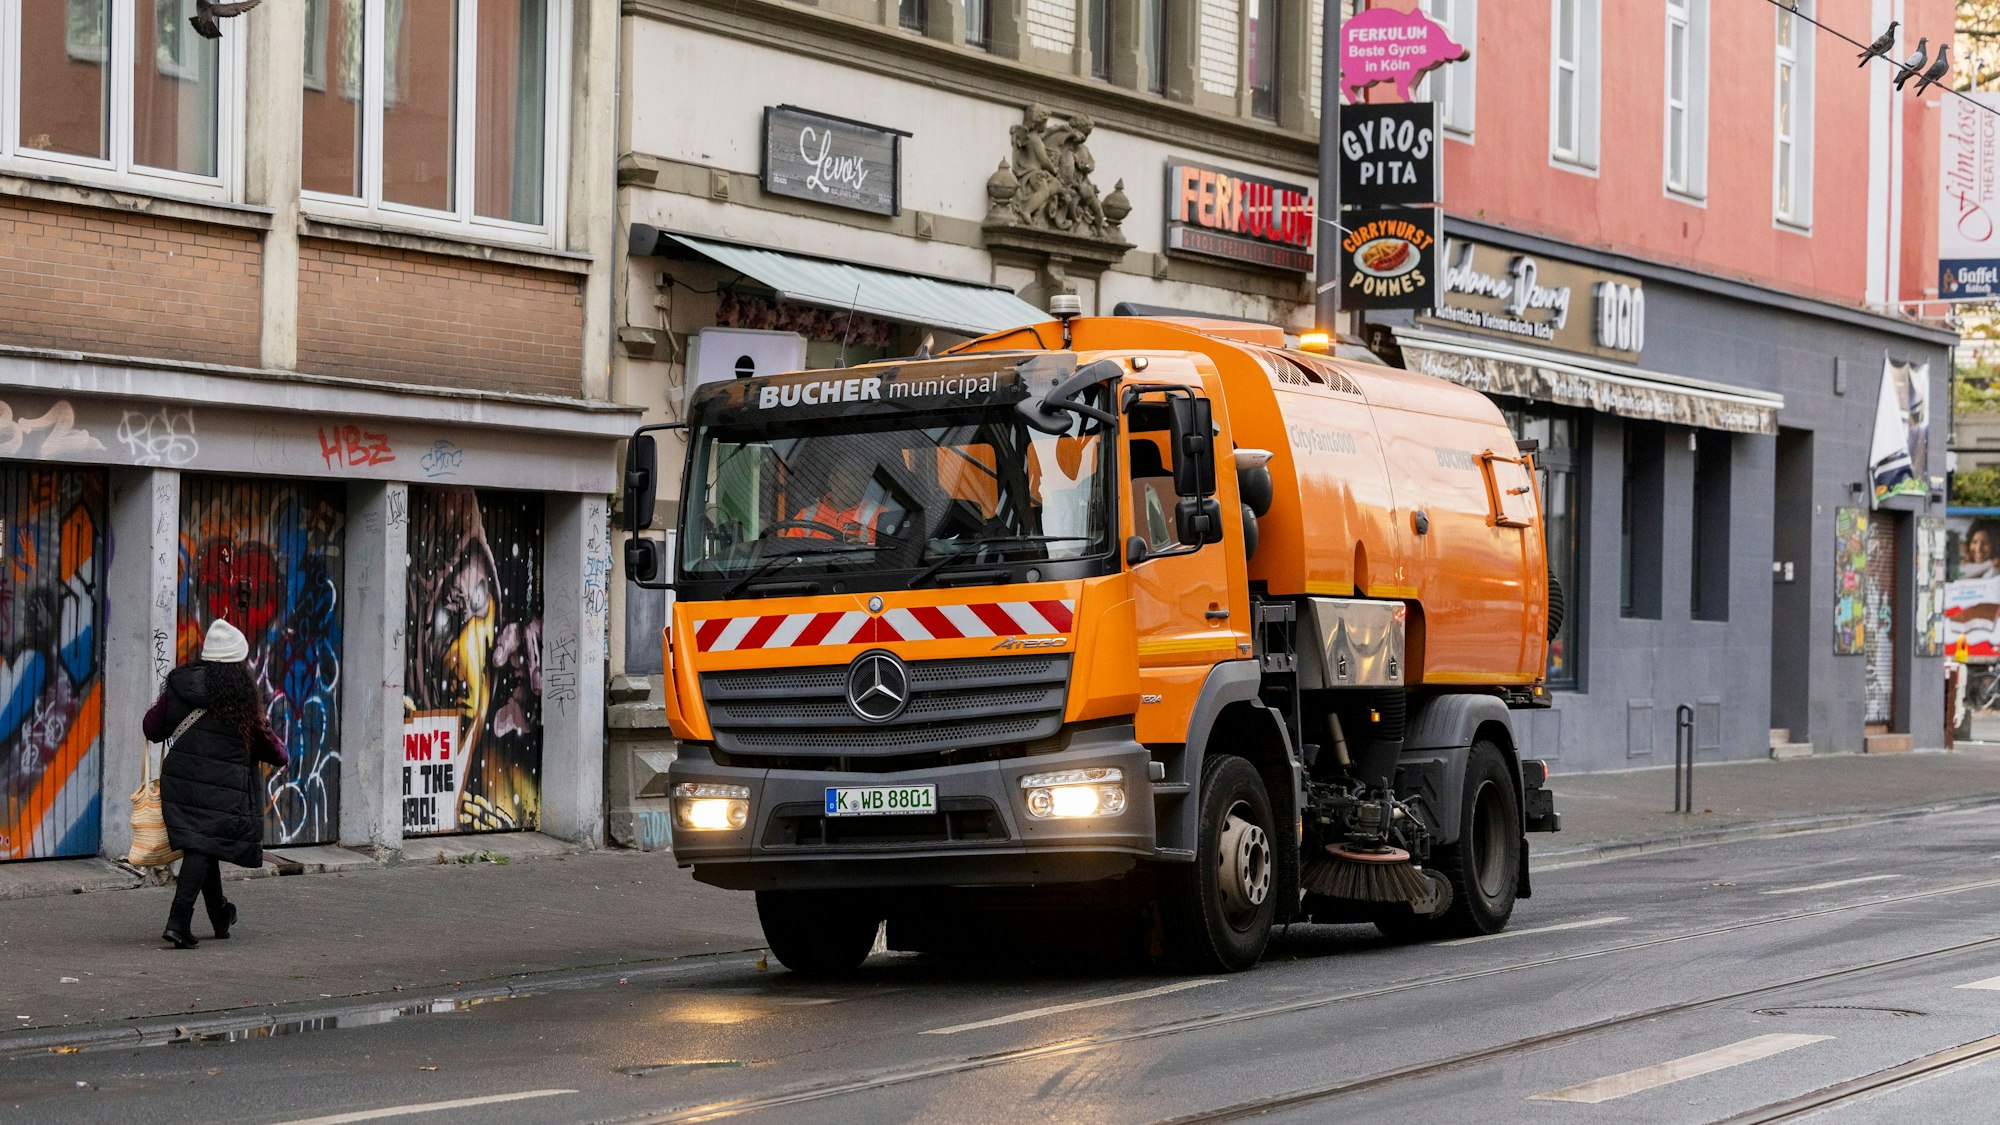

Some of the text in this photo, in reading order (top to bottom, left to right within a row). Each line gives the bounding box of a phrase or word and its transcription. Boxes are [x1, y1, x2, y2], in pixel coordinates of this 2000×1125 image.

[1348, 26, 1428, 42] FERKULUM
[1348, 43, 1428, 59] Beste Gyros
[1365, 59, 1411, 72] in Köln
[1342, 117, 1433, 162] GYROS
[800, 126, 869, 194] Levo's
[1359, 160, 1418, 185] PITA
[1180, 165, 1314, 248] FERKULUM
[1342, 219, 1434, 254] CURRYWURST
[1349, 268, 1427, 297] POMMES
[1443, 238, 1514, 300] adame
[1957, 266, 1999, 285] Gaffel
[758, 371, 998, 410] BUCHER municipal
[317, 424, 396, 472] HBZ
[1290, 423, 1357, 456] CityFant6000
[403, 729, 450, 761] NN'S
[420, 763, 454, 795] THE
[837, 788, 932, 809] K WB 8801
